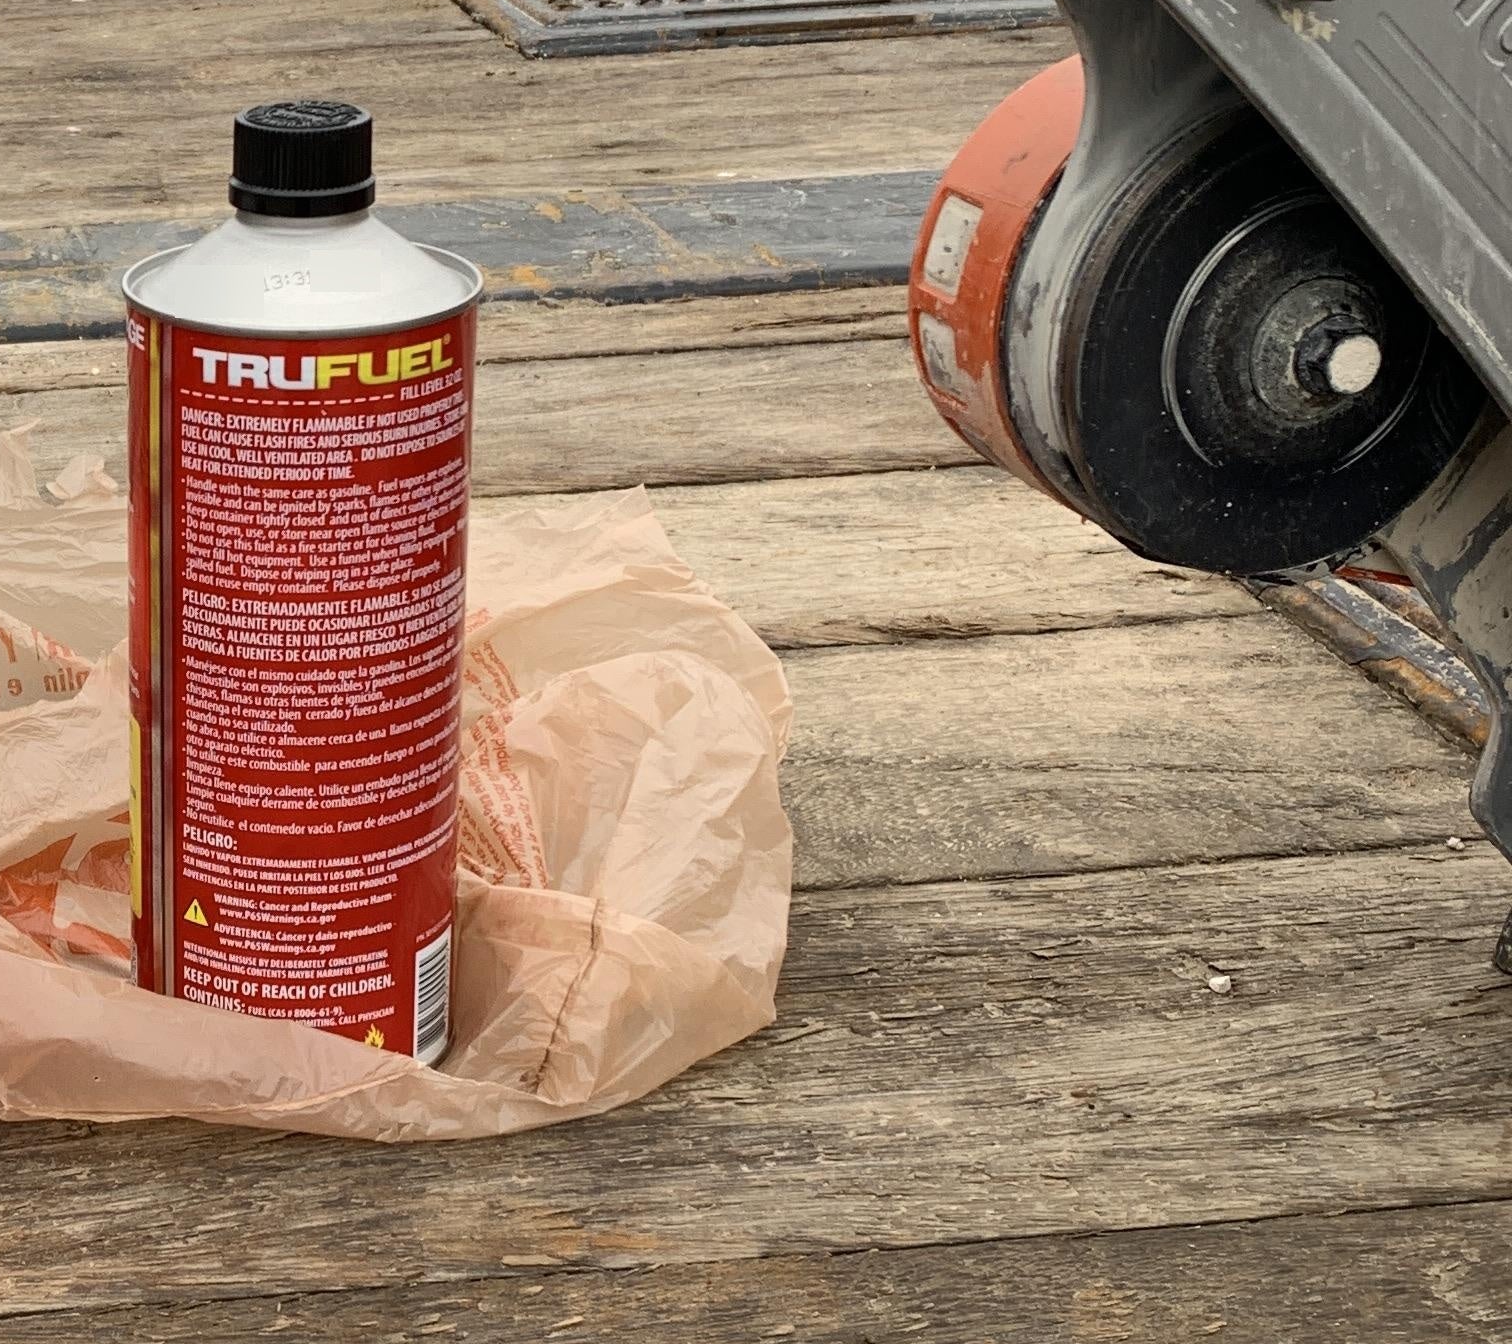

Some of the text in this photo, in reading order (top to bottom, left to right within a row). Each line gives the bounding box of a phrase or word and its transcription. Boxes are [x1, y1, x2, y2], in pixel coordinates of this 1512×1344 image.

[183, 822, 237, 850] PELIGRO:
[233, 880, 244, 891] EN
[245, 882, 255, 893] LA
[256, 883, 282, 895] PARTE
[282, 884, 328, 895] POSTERIOR
[328, 883, 339, 894] DE
[339, 880, 358, 893] ESTE
[213, 889, 392, 914] WARNING: Cancer and Reproductive Harm
[213, 922, 274, 941] ADVERTENCIA:
[307, 933, 314, 944] y
[338, 918, 392, 942] reproductivo
[227, 953, 257, 967] MISUSE
[257, 957, 269, 968] BY
[269, 958, 327, 969] DELIBERATELY
[183, 965, 395, 1000] KEEP OUT OF REACH OF CHILDREN.
[183, 983, 245, 1013] CONTAINS:
[247, 1005, 266, 1017] FUEL
[337, 1013, 356, 1026] CALL
[357, 1003, 394, 1023] PHYSICIAN
